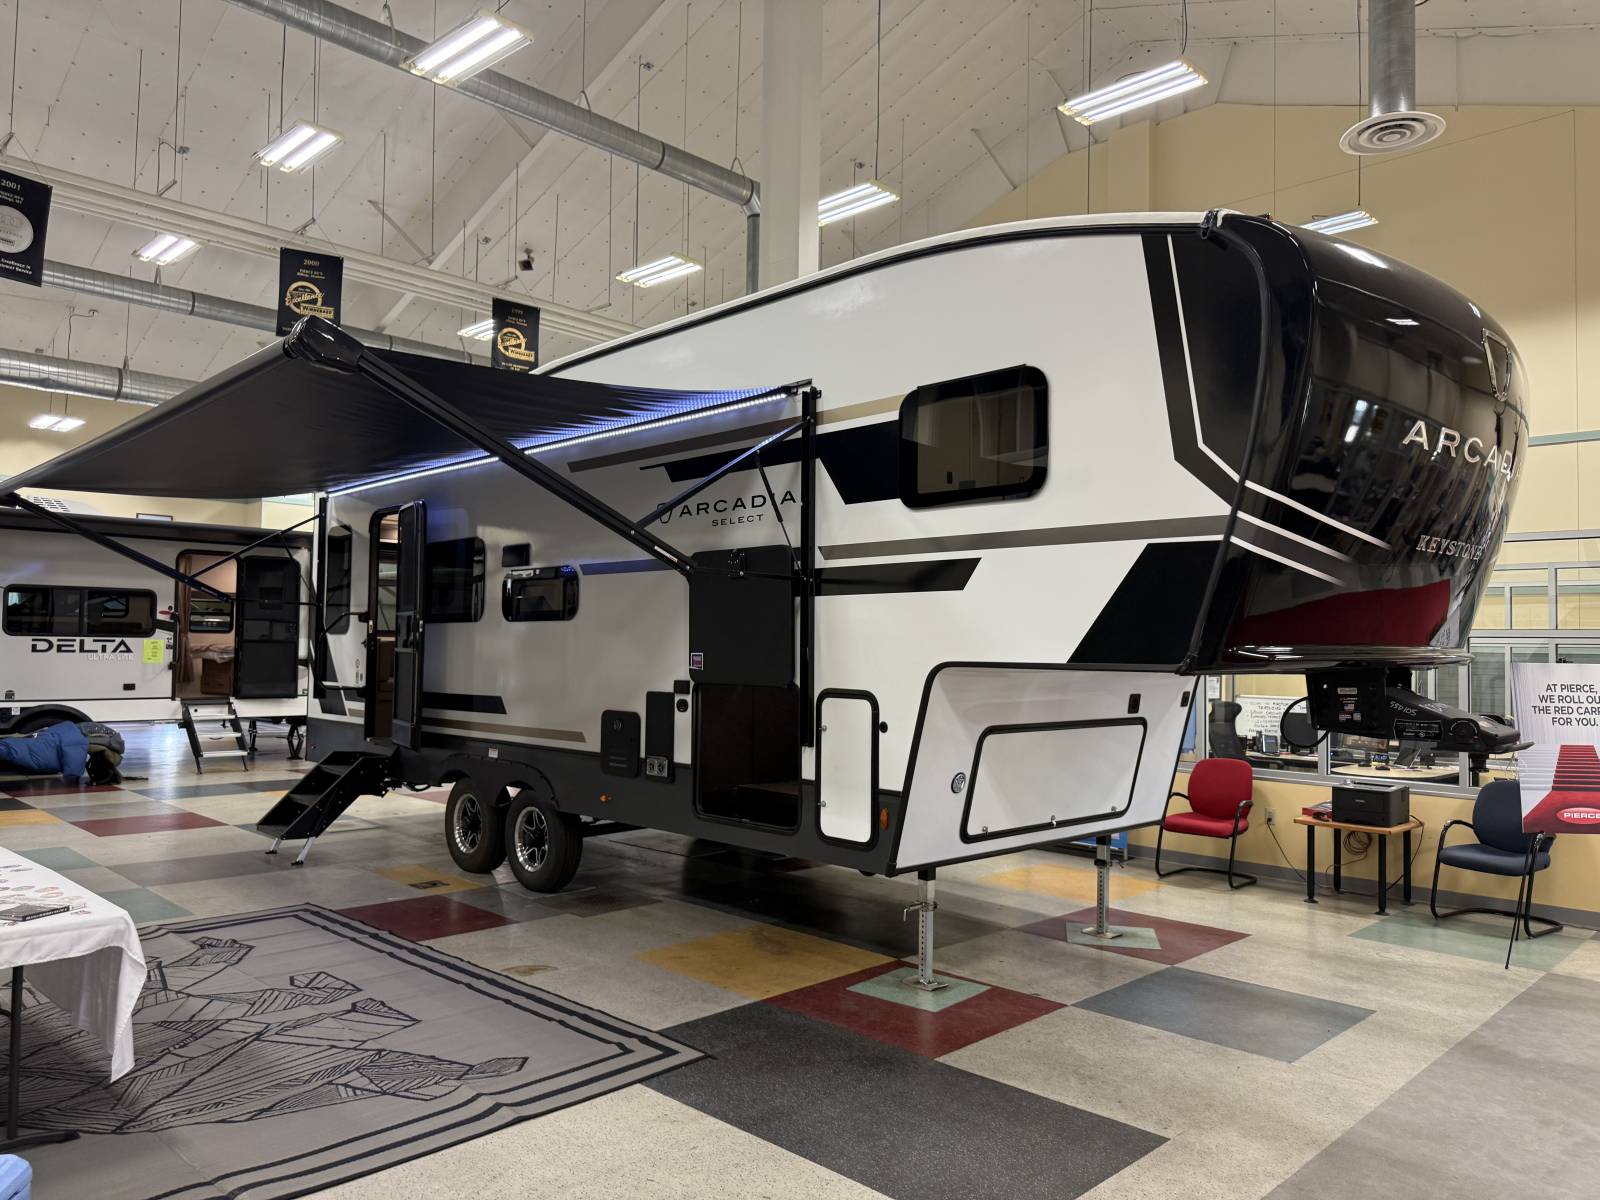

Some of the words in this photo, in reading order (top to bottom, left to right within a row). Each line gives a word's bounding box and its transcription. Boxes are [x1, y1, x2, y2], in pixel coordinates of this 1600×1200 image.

[711, 514, 764, 527] SELECT
[1415, 534, 1483, 561] KEYSTONE
[31, 638, 134, 654] DELTA
[1545, 683, 1558, 693] AT
[1560, 683, 1598, 695] PIERCE,
[1538, 694, 1556, 704] WE
[1557, 695, 1584, 704] ROLL
[1531, 705, 1552, 715] THE
[1553, 705, 1574, 715] RED
[1551, 716, 1573, 727] FOR
[1574, 717, 1599, 727] YOU.
